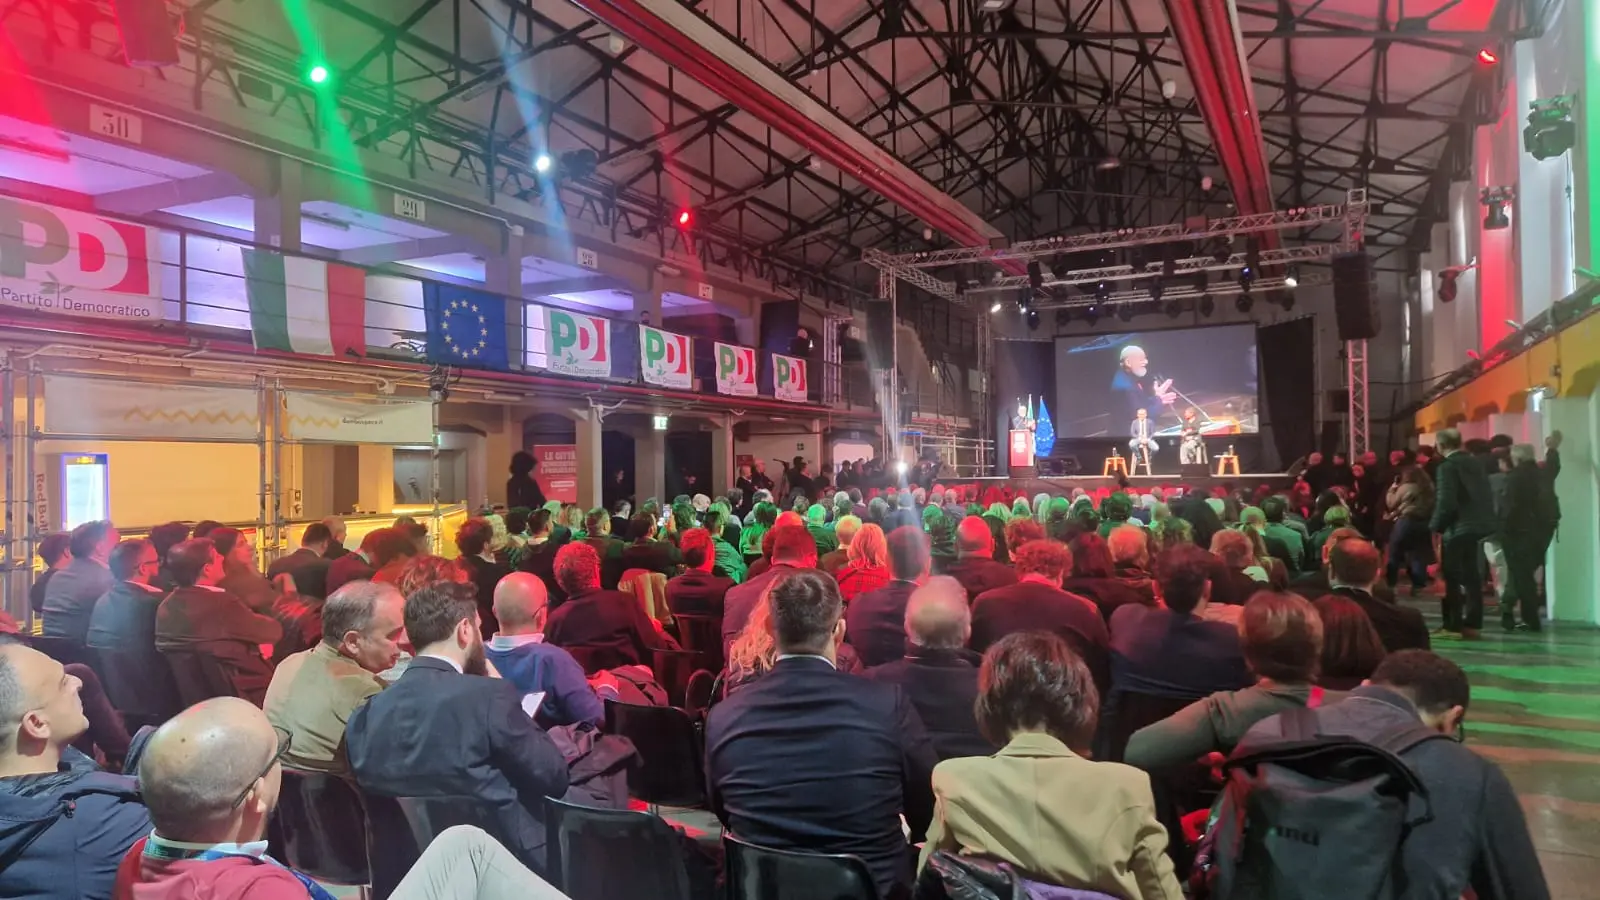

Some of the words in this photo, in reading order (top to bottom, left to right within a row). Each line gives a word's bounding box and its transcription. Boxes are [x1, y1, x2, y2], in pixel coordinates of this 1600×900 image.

[102, 111, 129, 138] 30
[0, 197, 149, 296] PD
[1, 287, 52, 308] Partito
[63, 298, 150, 317] Democratico
[550, 310, 607, 362] PD
[645, 327, 688, 374] PD
[719, 345, 755, 384] PD
[775, 356, 806, 391] PD
[36, 473, 47, 502] Red
[38, 504, 49, 531] Bull
